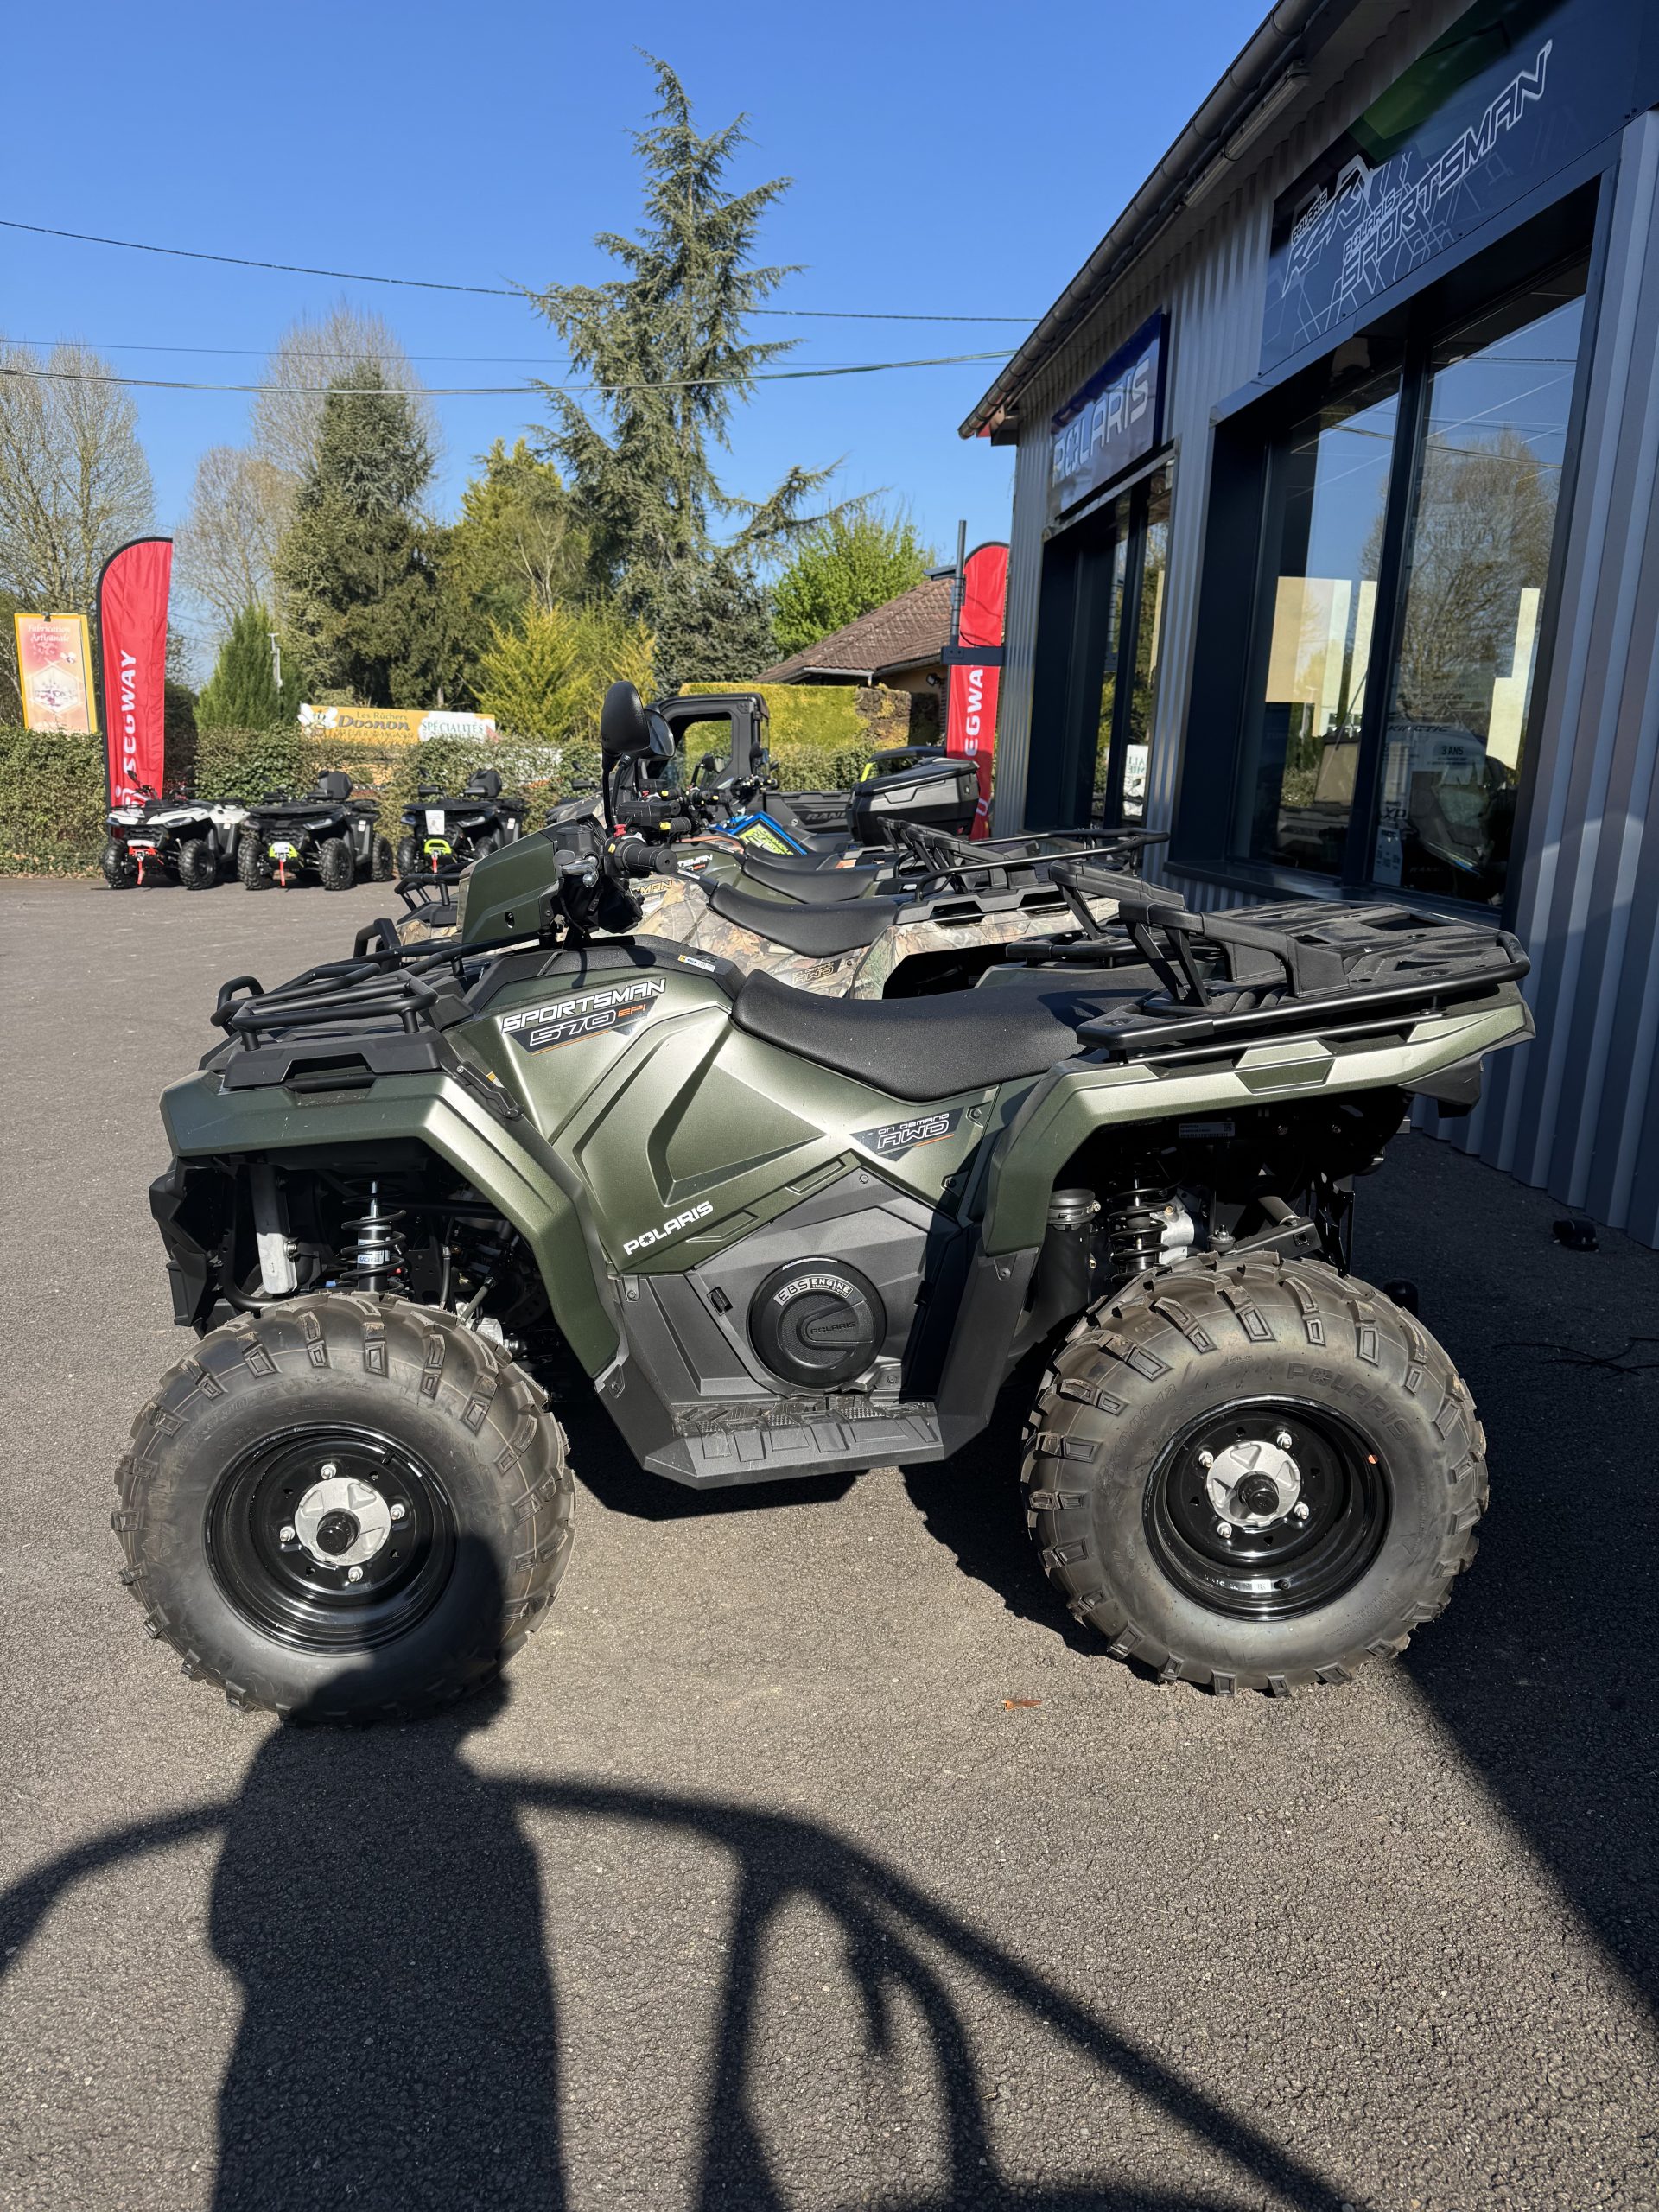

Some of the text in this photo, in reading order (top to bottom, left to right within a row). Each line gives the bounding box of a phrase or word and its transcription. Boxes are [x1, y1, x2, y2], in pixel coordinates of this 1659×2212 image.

[1052, 357, 1150, 488] POLARIS
[338, 715, 410, 731] Dosnon
[357, 711, 371, 720] Les
[964, 668, 984, 757] EGWA
[792, 966, 835, 985] AWD
[501, 977, 666, 1033] SPORTSMAN
[529, 1003, 646, 1046] 570 EFI
[877, 1119, 950, 1149] AWD
[878, 1113, 950, 1135] ON DEMAND
[623, 1200, 714, 1255] POLARIS
[777, 1278, 850, 1302] EBS ENGINE
[810, 1321, 856, 1335] POLARIS
[1286, 1362, 1412, 1441] POLARIS
